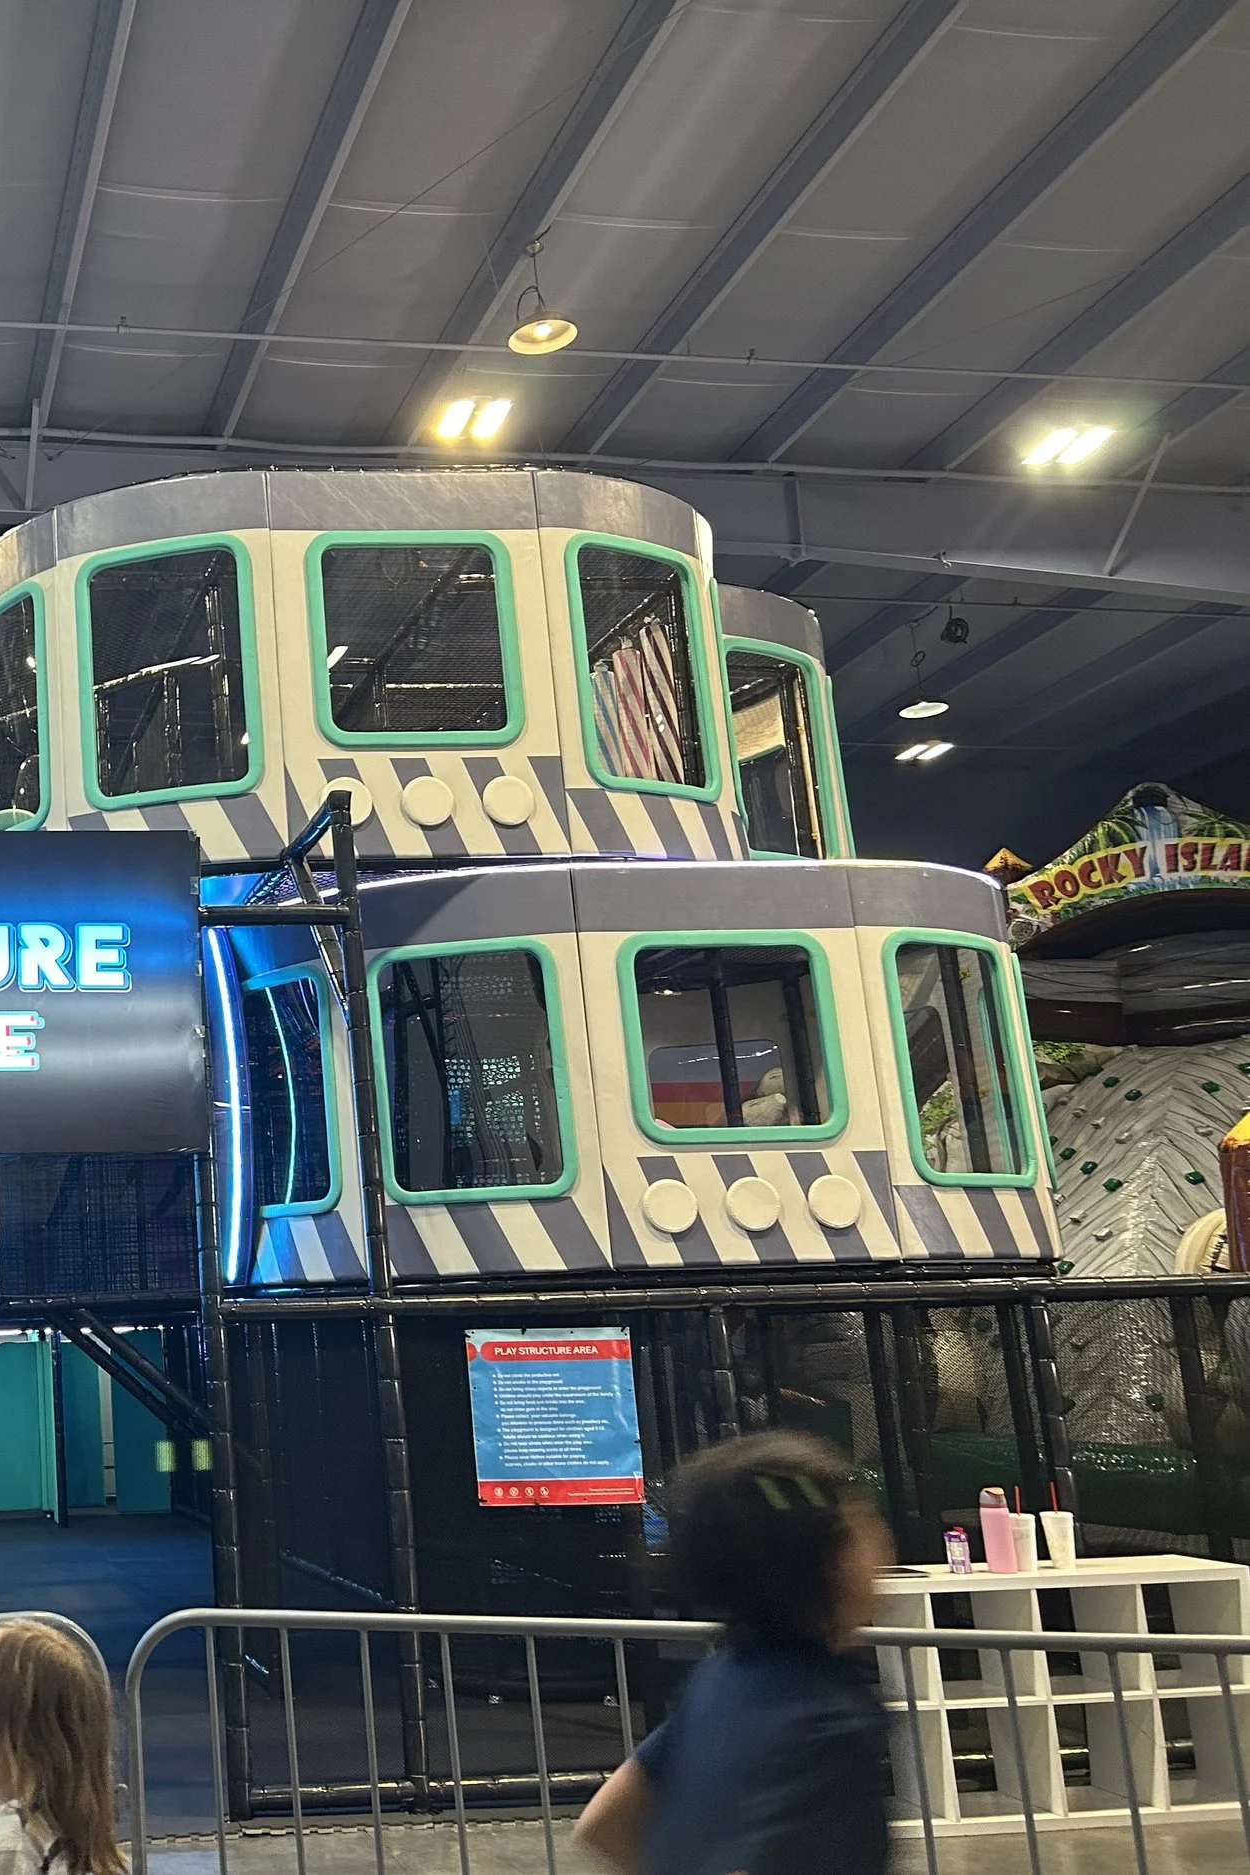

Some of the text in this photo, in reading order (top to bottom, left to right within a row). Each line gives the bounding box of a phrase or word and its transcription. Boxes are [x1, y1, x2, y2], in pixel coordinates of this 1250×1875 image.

[1027, 847, 1149, 910] ROCKY
[494, 1345, 599, 1356] PLAY STRUCTURE AREA
